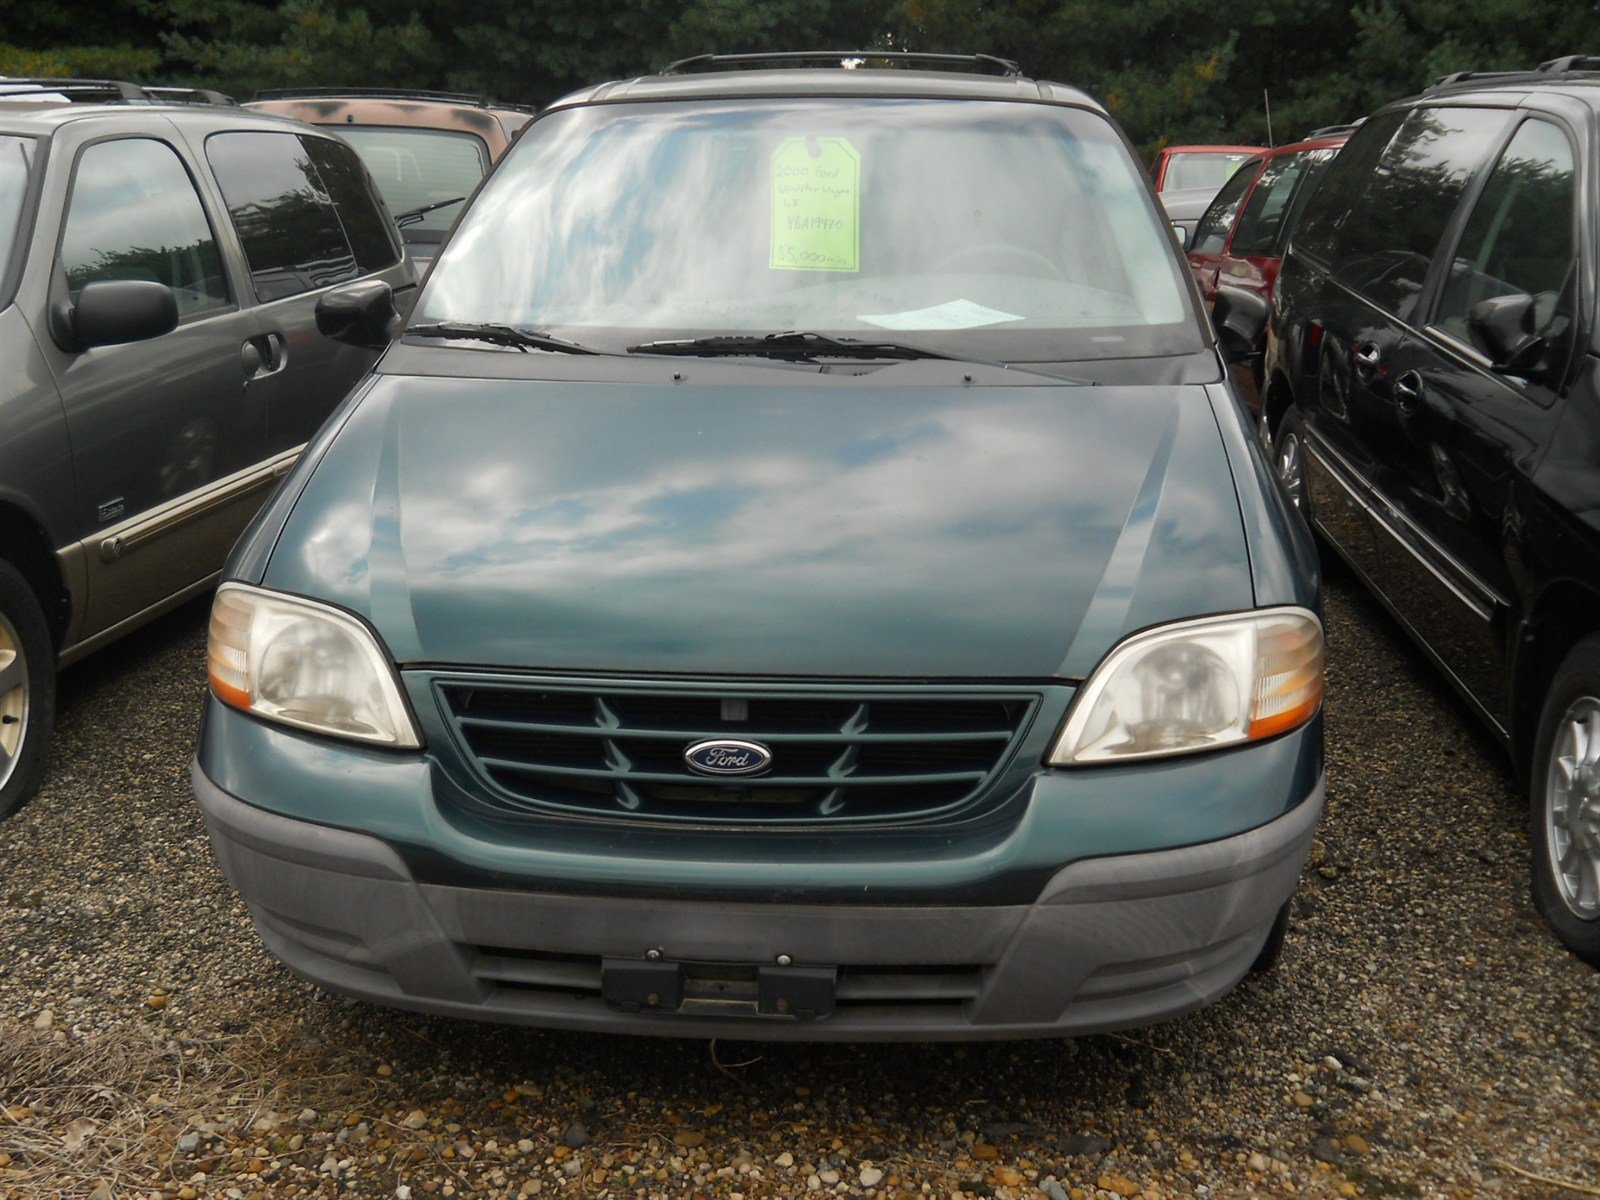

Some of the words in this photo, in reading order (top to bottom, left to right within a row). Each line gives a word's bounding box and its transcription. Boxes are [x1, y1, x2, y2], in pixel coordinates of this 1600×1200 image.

[776, 163, 809, 178] 2000
[815, 164, 840, 178] Ford
[783, 198, 800, 207] LX
[778, 245, 826, 264] 55,000
[705, 747, 749, 766] Ford
